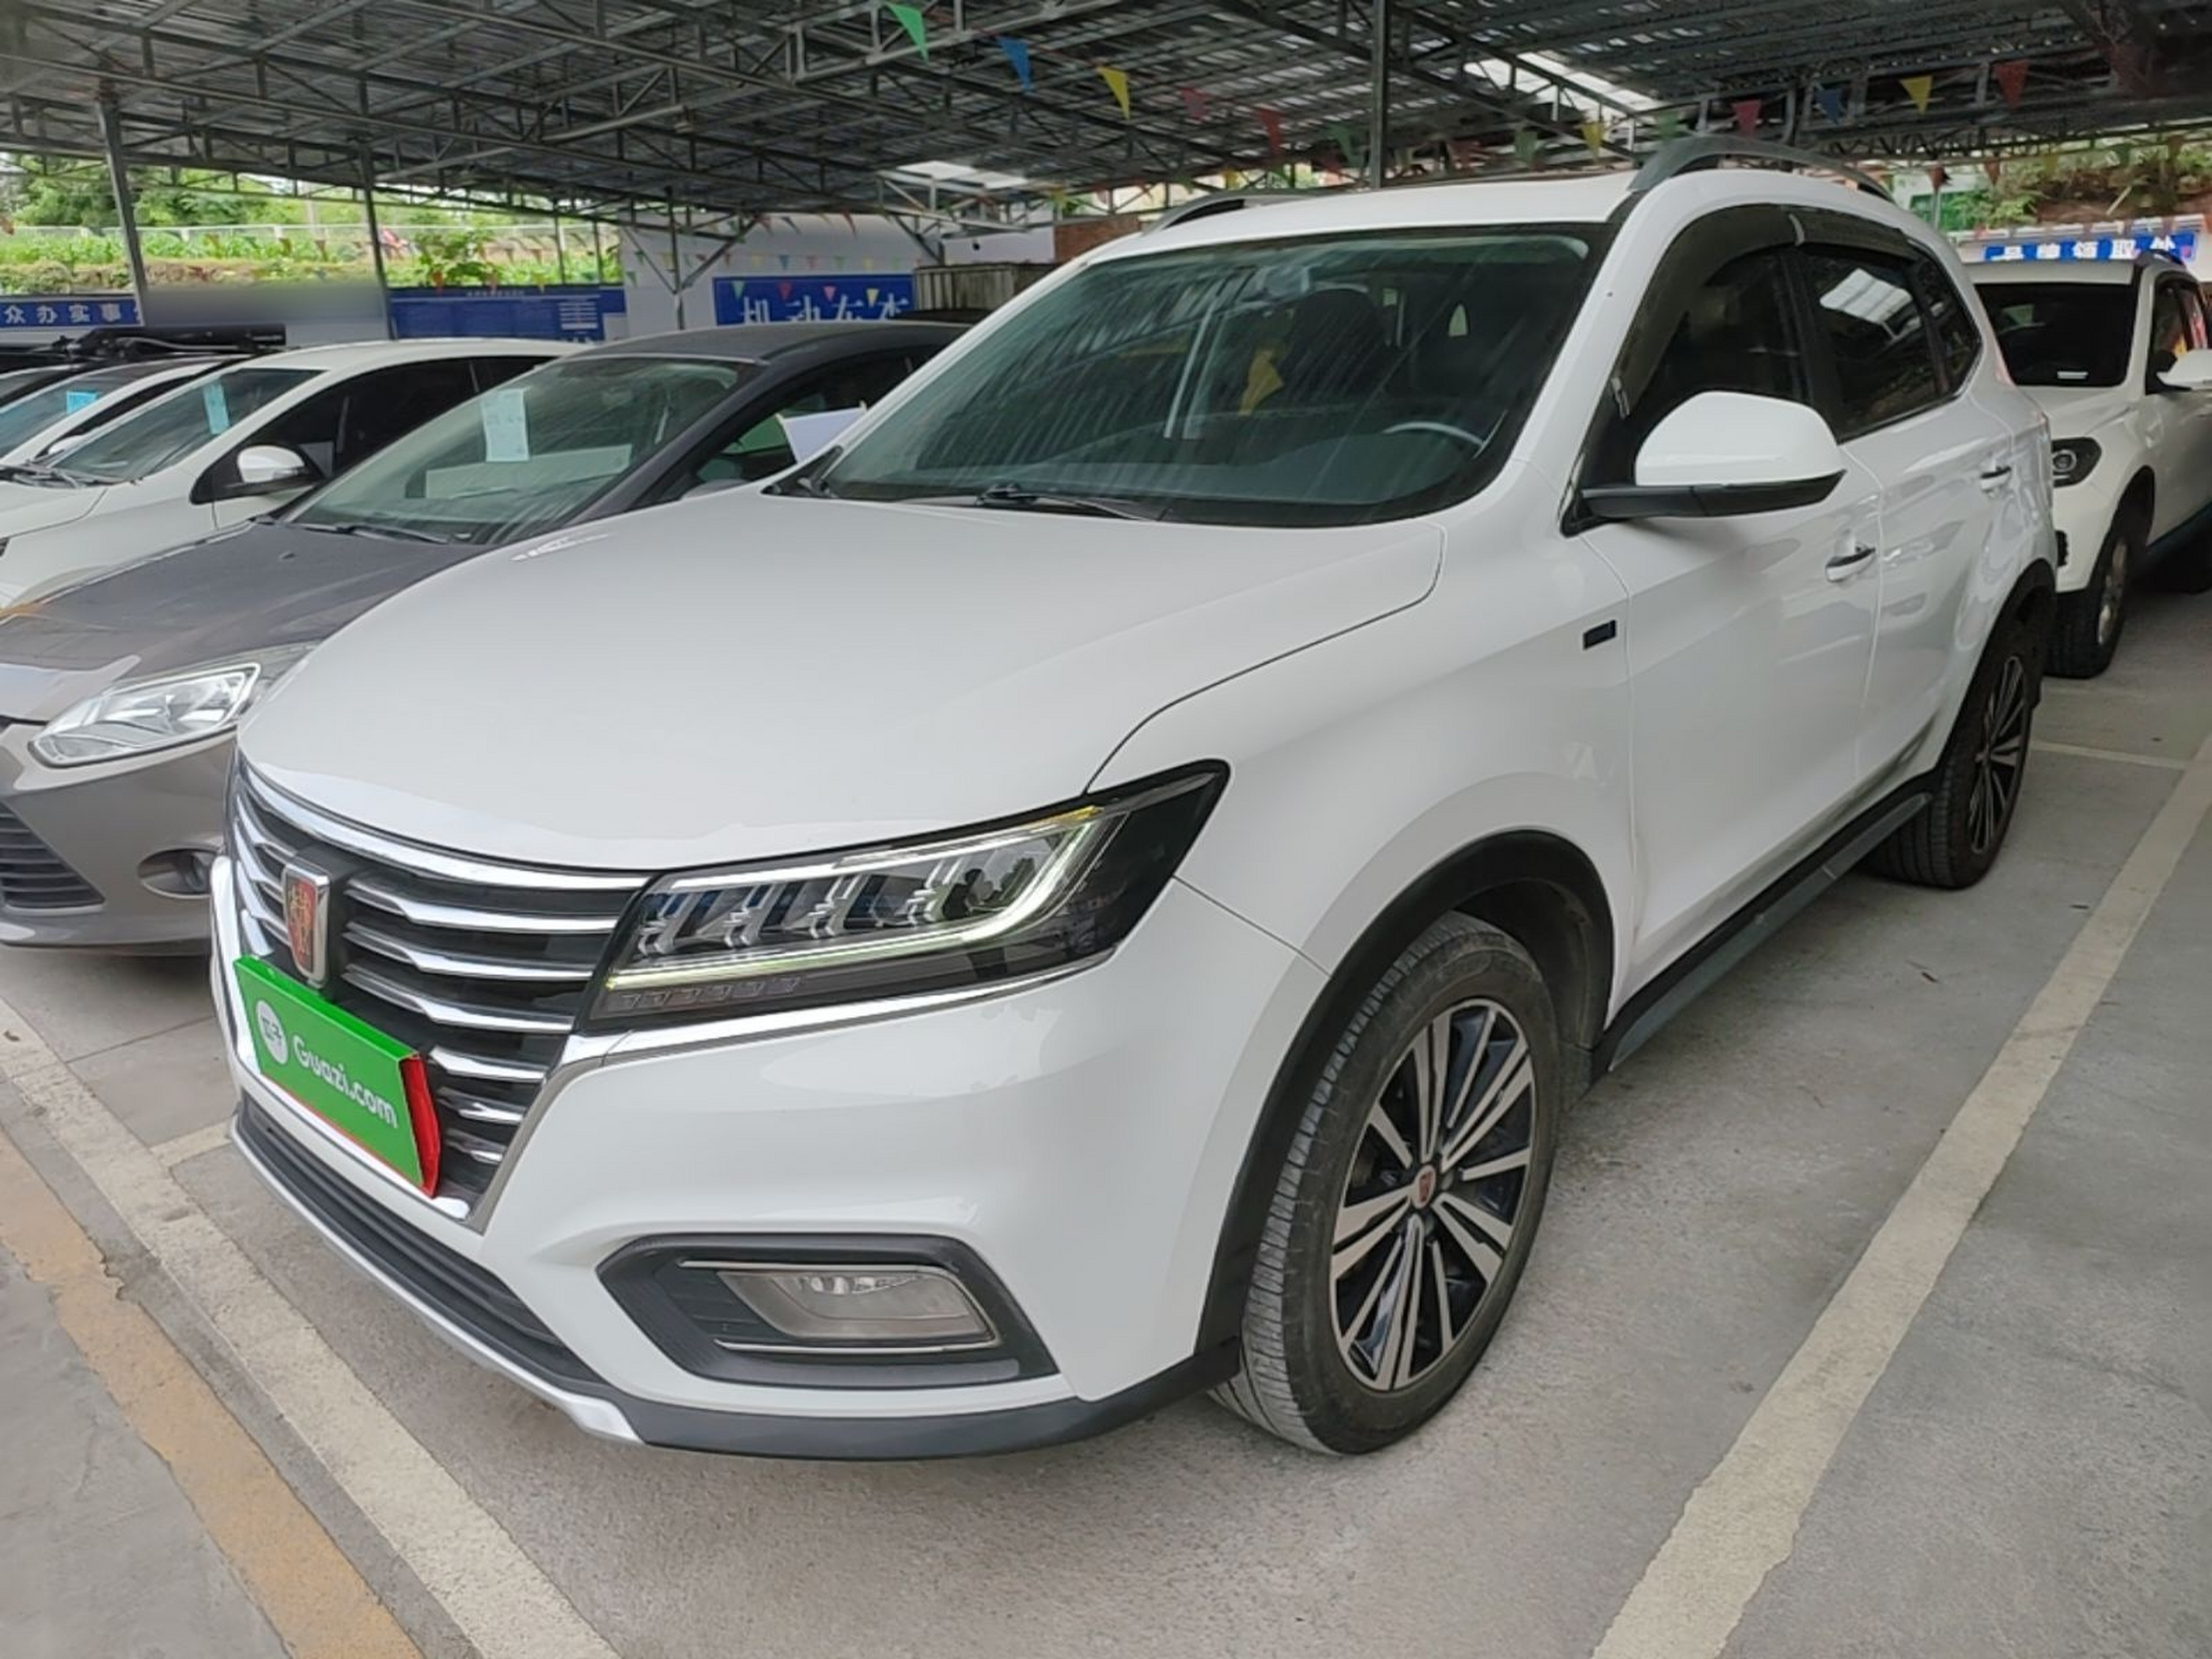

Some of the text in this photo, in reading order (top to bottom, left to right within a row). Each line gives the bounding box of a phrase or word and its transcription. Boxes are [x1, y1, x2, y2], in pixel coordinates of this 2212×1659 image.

[3, 303, 140, 324] 众办实事
[293, 1035, 397, 1128] Guazi.com
